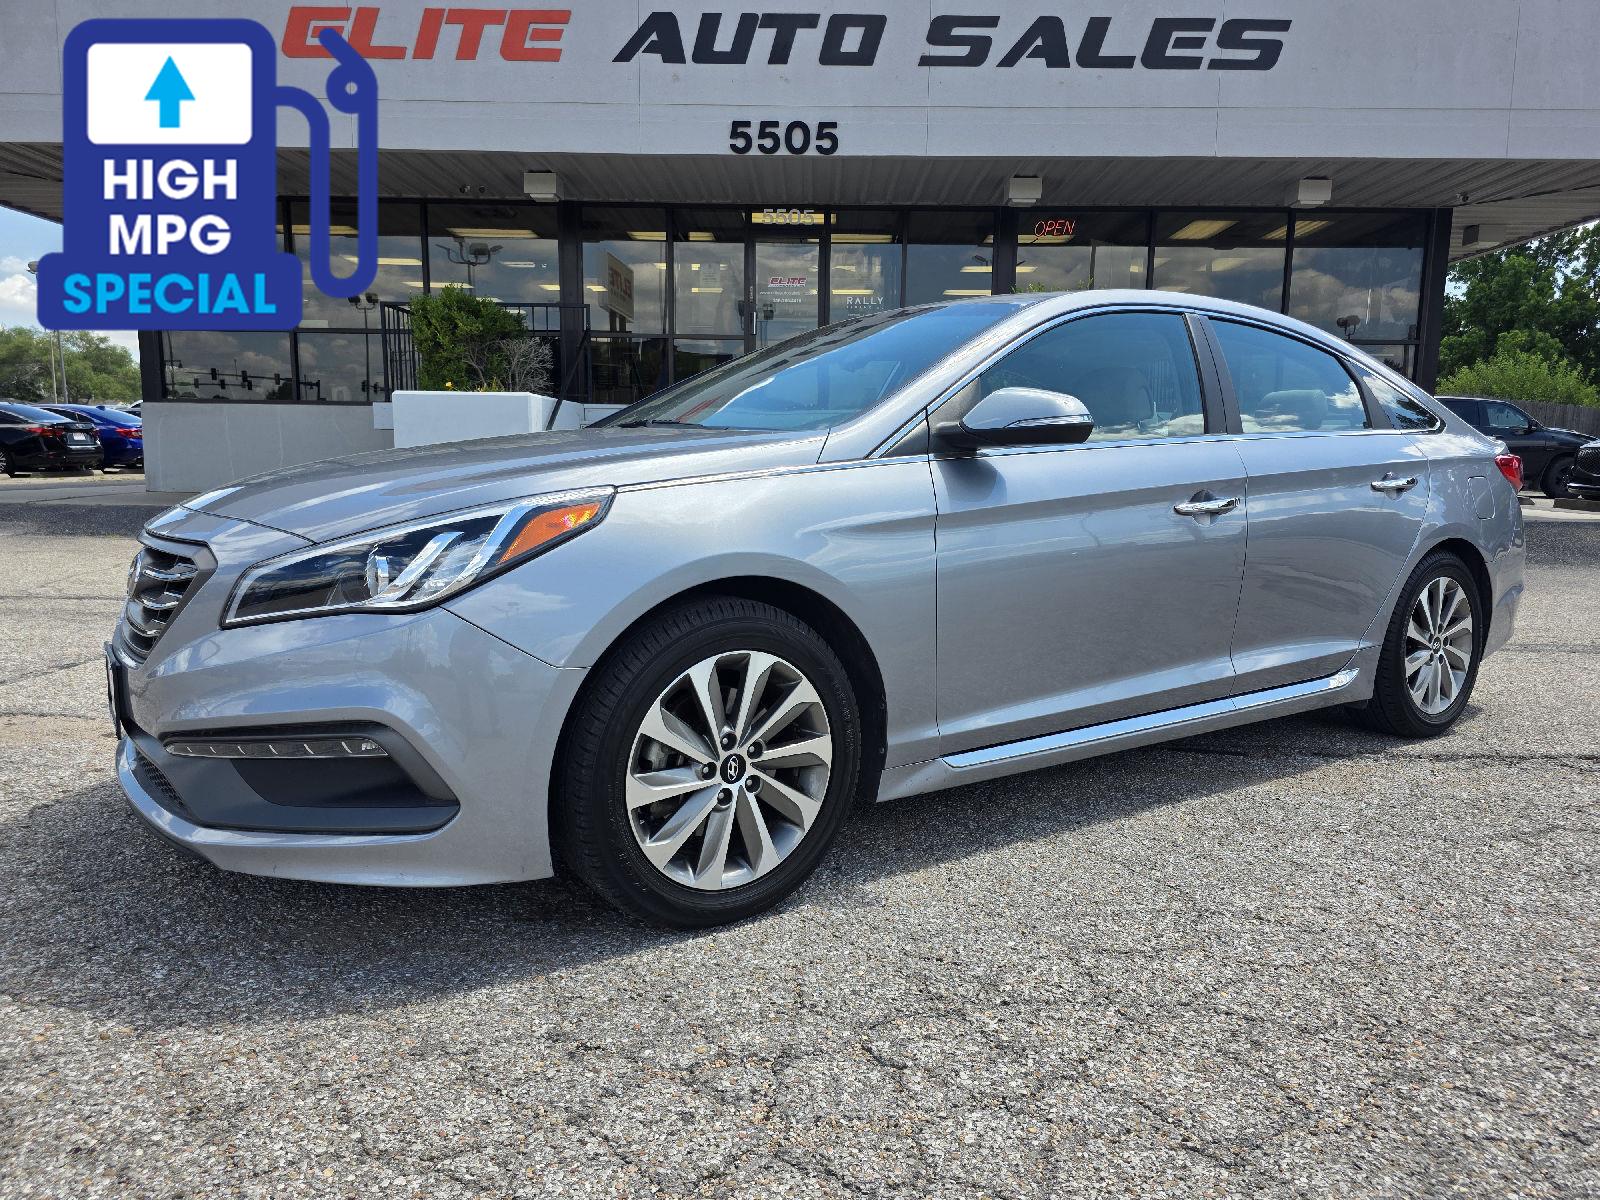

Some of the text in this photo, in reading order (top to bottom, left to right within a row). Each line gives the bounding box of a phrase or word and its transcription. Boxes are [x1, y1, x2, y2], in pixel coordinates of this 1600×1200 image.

[282, 7, 1292, 71] ELITE AUTO SALES
[729, 120, 839, 155] 5505
[762, 208, 815, 225] 5505
[1034, 220, 1075, 237] OPEN
[768, 277, 807, 285] ELITE
[846, 296, 884, 305] RALLY
